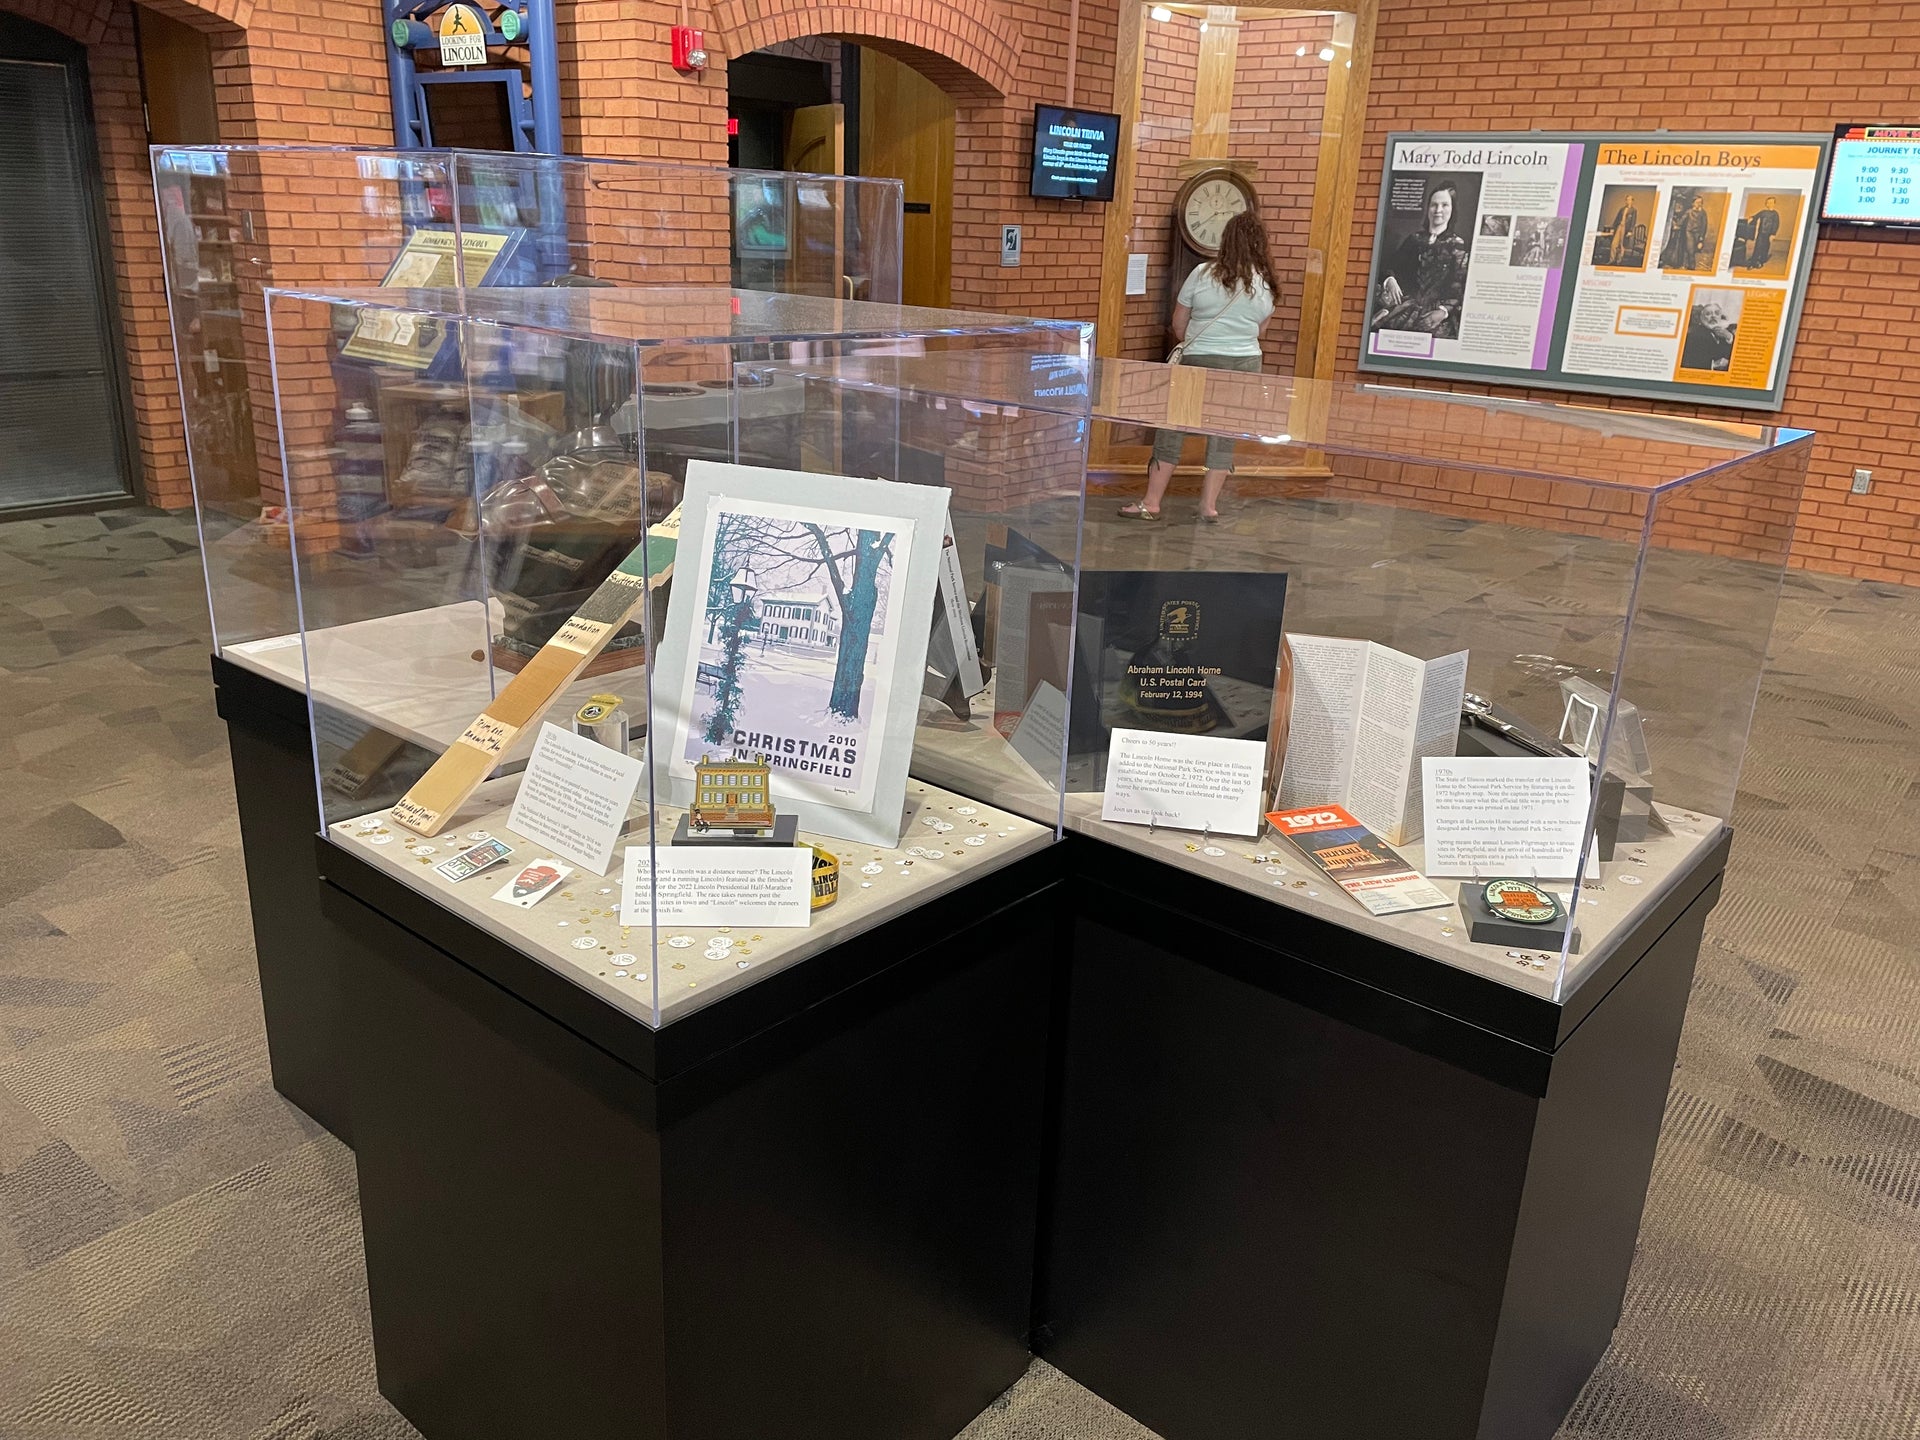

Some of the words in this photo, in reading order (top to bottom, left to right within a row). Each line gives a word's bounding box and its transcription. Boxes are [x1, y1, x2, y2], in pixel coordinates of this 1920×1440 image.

[442, 37, 466, 45] LOOKING
[443, 46, 484, 61] LINCOLN
[1049, 124, 1080, 138] LINCOLN
[1082, 129, 1104, 140] TRIVIA
[1867, 146, 1909, 155] JOURNEY
[1399, 150, 1440, 168] Mary
[1444, 150, 1481, 165] Todd
[1486, 150, 1548, 166] Lincoln
[1604, 150, 1637, 165] The
[1643, 150, 1711, 166] Lincoln
[1716, 152, 1761, 171] Boys
[1747, 290, 1778, 298] LEGACY
[564, 619, 600, 634] Foundation
[1127, 666, 1163, 674] Abraham
[1166, 666, 1194, 674] Lincoln
[1197, 666, 1221, 674] Home
[1160, 678, 1184, 686] Postal
[1140, 691, 1170, 699] February
[733, 729, 857, 764] CHRISTMAS
[828, 735, 857, 747] 2010
[733, 748, 748, 761] IN
[1144, 778, 1177, 788] significance
[1185, 790, 1214, 798] celebrated
[1281, 812, 1342, 828] 1972
[1383, 875, 1420, 884] ILLINOIS
